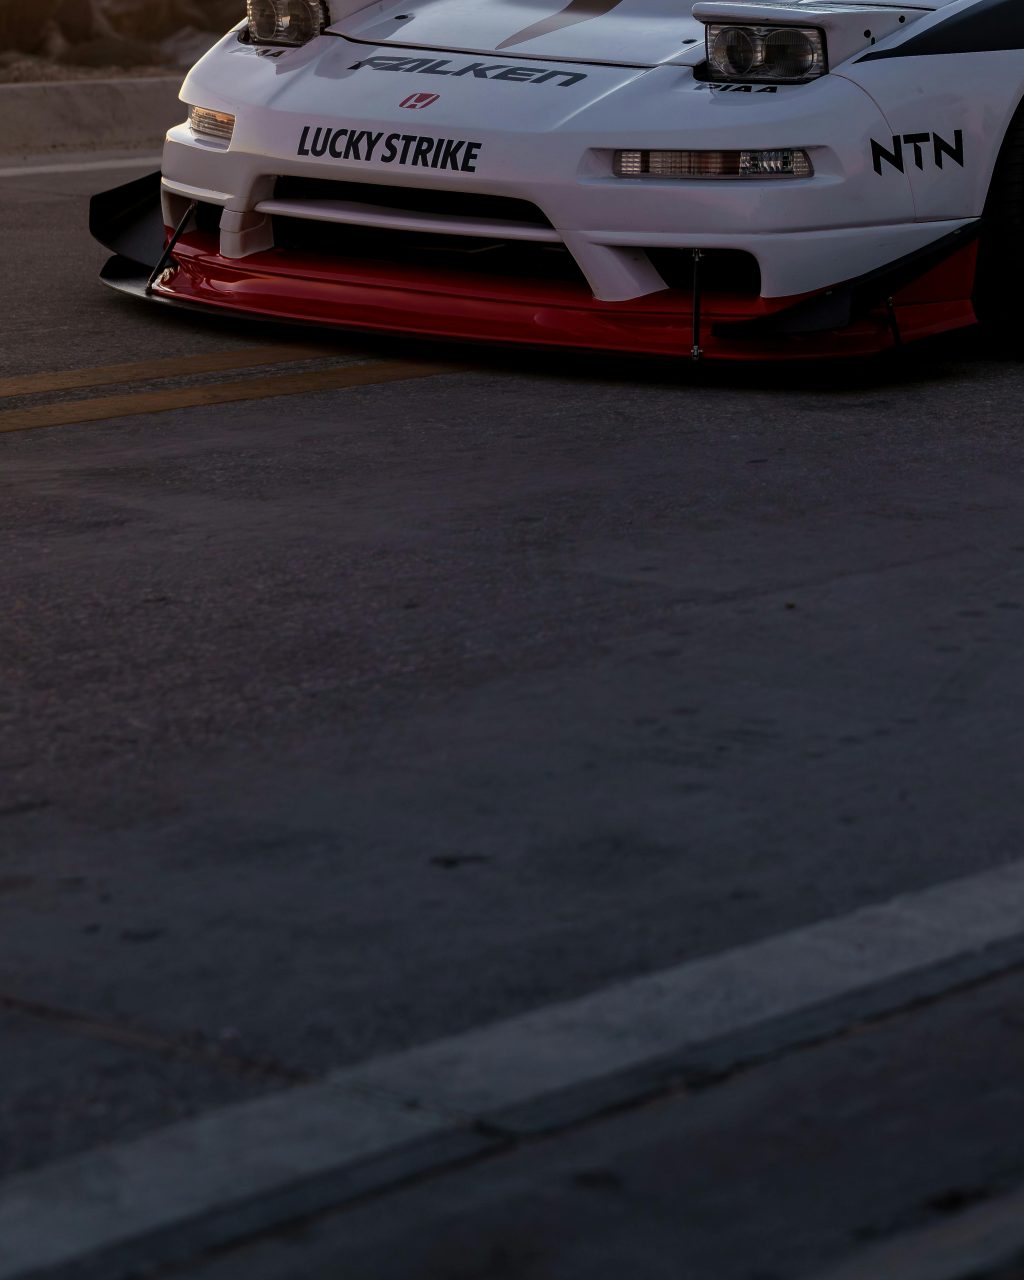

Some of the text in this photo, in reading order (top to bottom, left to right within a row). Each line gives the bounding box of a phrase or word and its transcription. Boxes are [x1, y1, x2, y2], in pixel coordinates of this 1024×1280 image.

[346, 55, 589, 88] FALKEN
[297, 126, 483, 173] LUCKY STRIKE
[869, 129, 964, 176] NTN
